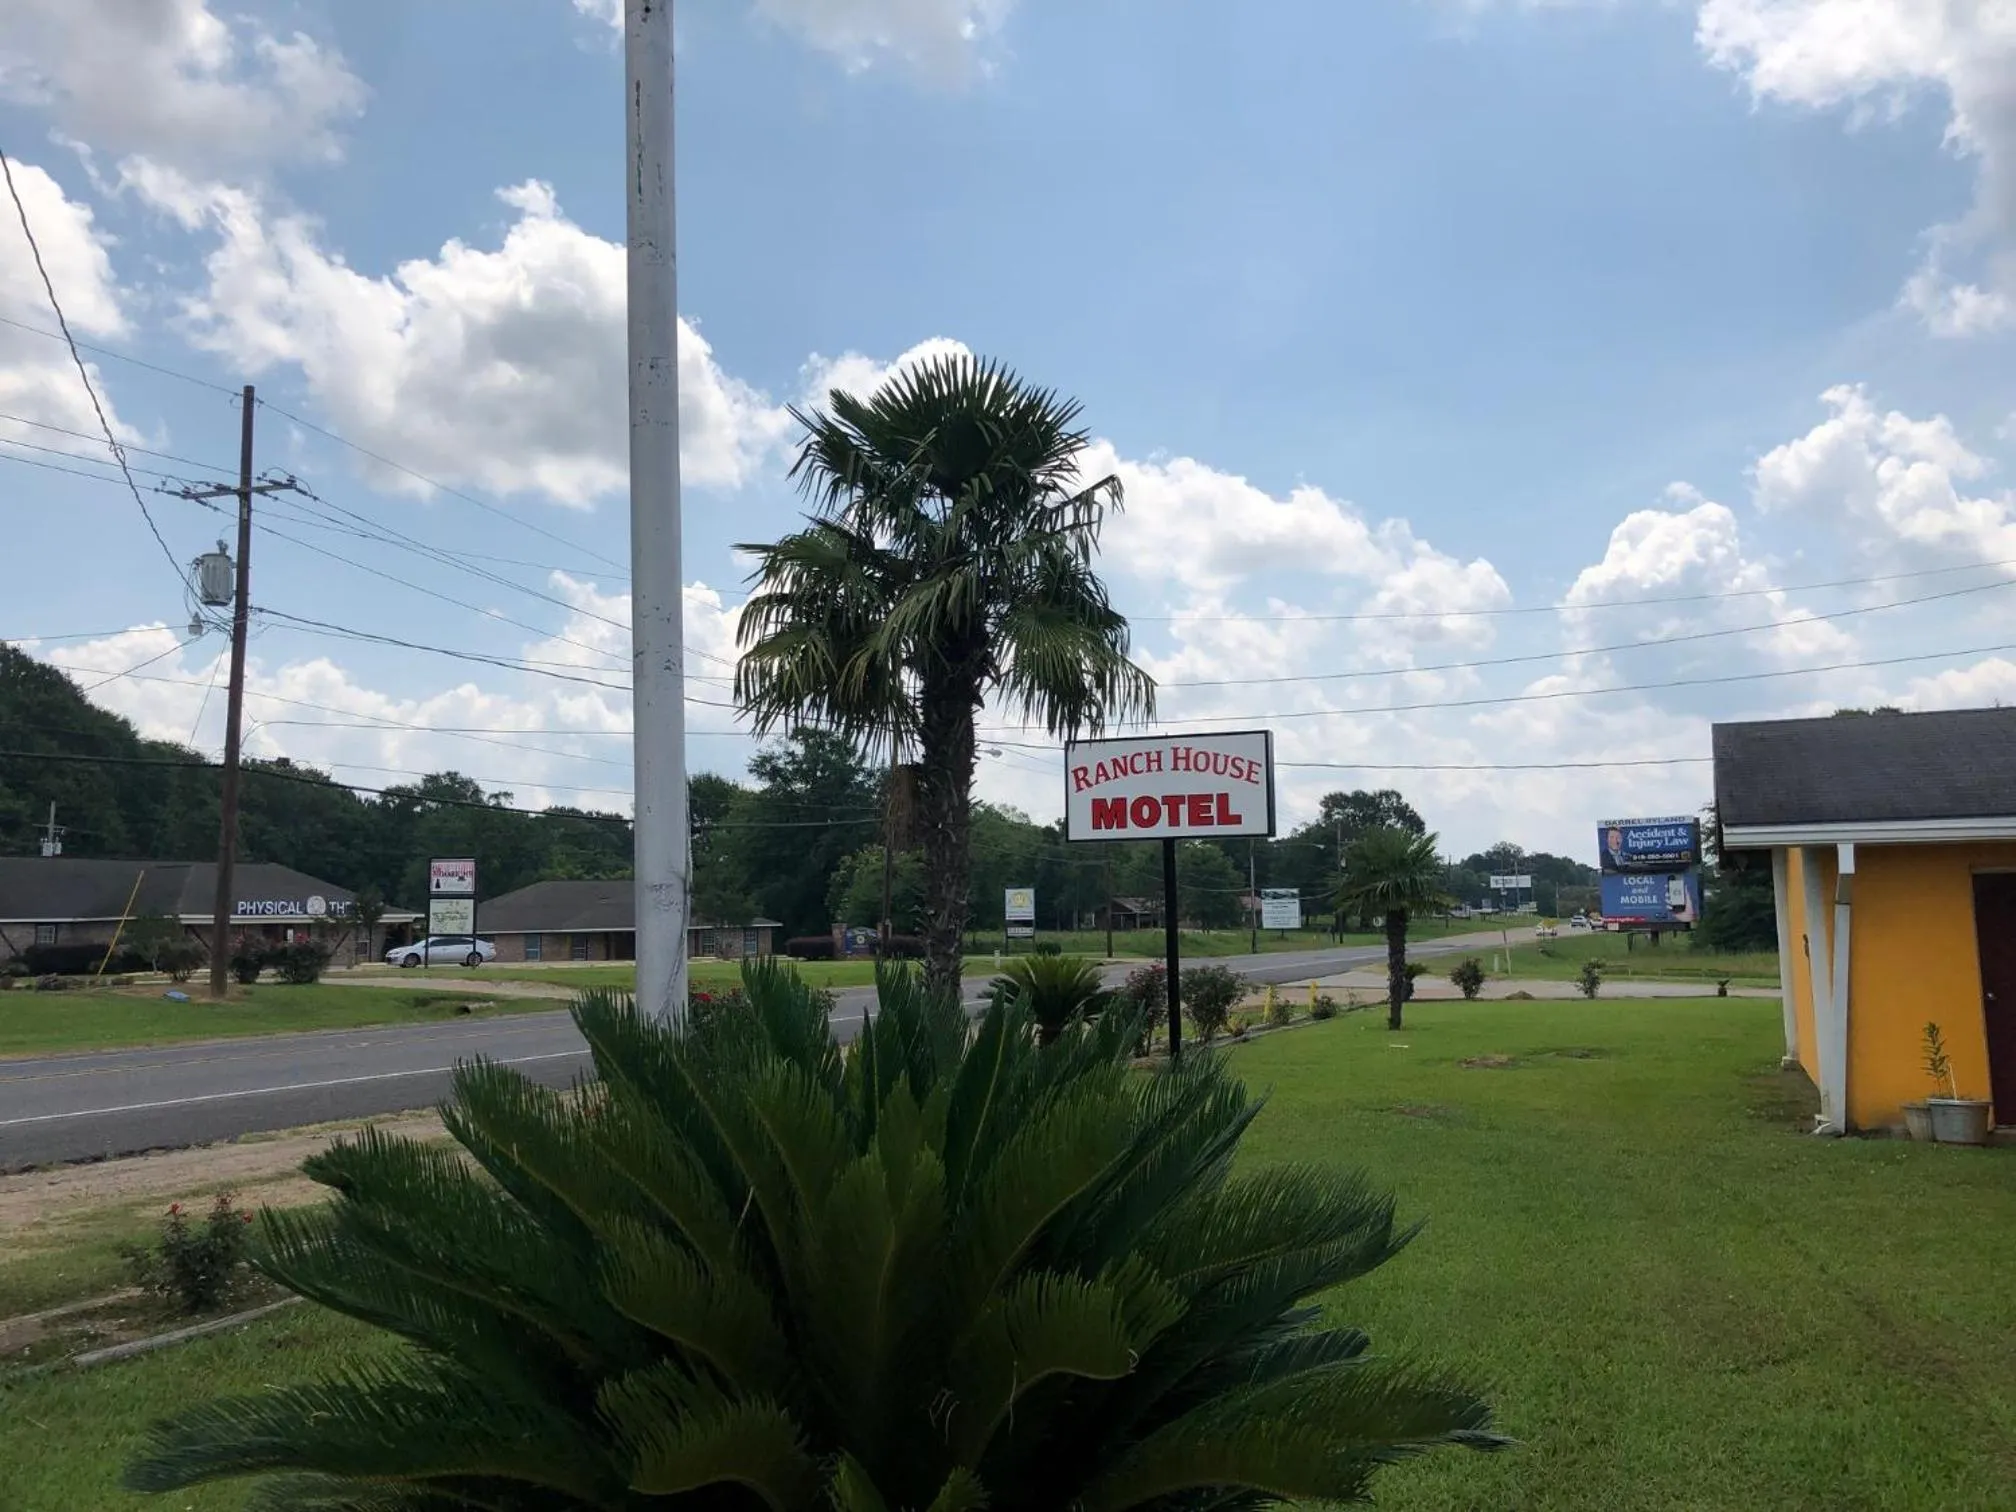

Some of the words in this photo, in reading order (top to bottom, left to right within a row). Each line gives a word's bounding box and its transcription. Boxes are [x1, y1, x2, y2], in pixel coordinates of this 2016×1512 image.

[1071, 750, 1163, 793] RANCH
[1170, 746, 1262, 785] HOUSE
[1092, 793, 1242, 830] MOTEL
[1627, 827, 1676, 839] Accident
[1677, 827, 1687, 837] &
[1628, 838, 1663, 849] Injury
[1665, 836, 1689, 846] Law
[1623, 876, 1655, 886] LOCAL
[1631, 886, 1648, 894] and
[1620, 895, 1658, 905] MOBILE
[237, 900, 303, 915] PHYSICAL
